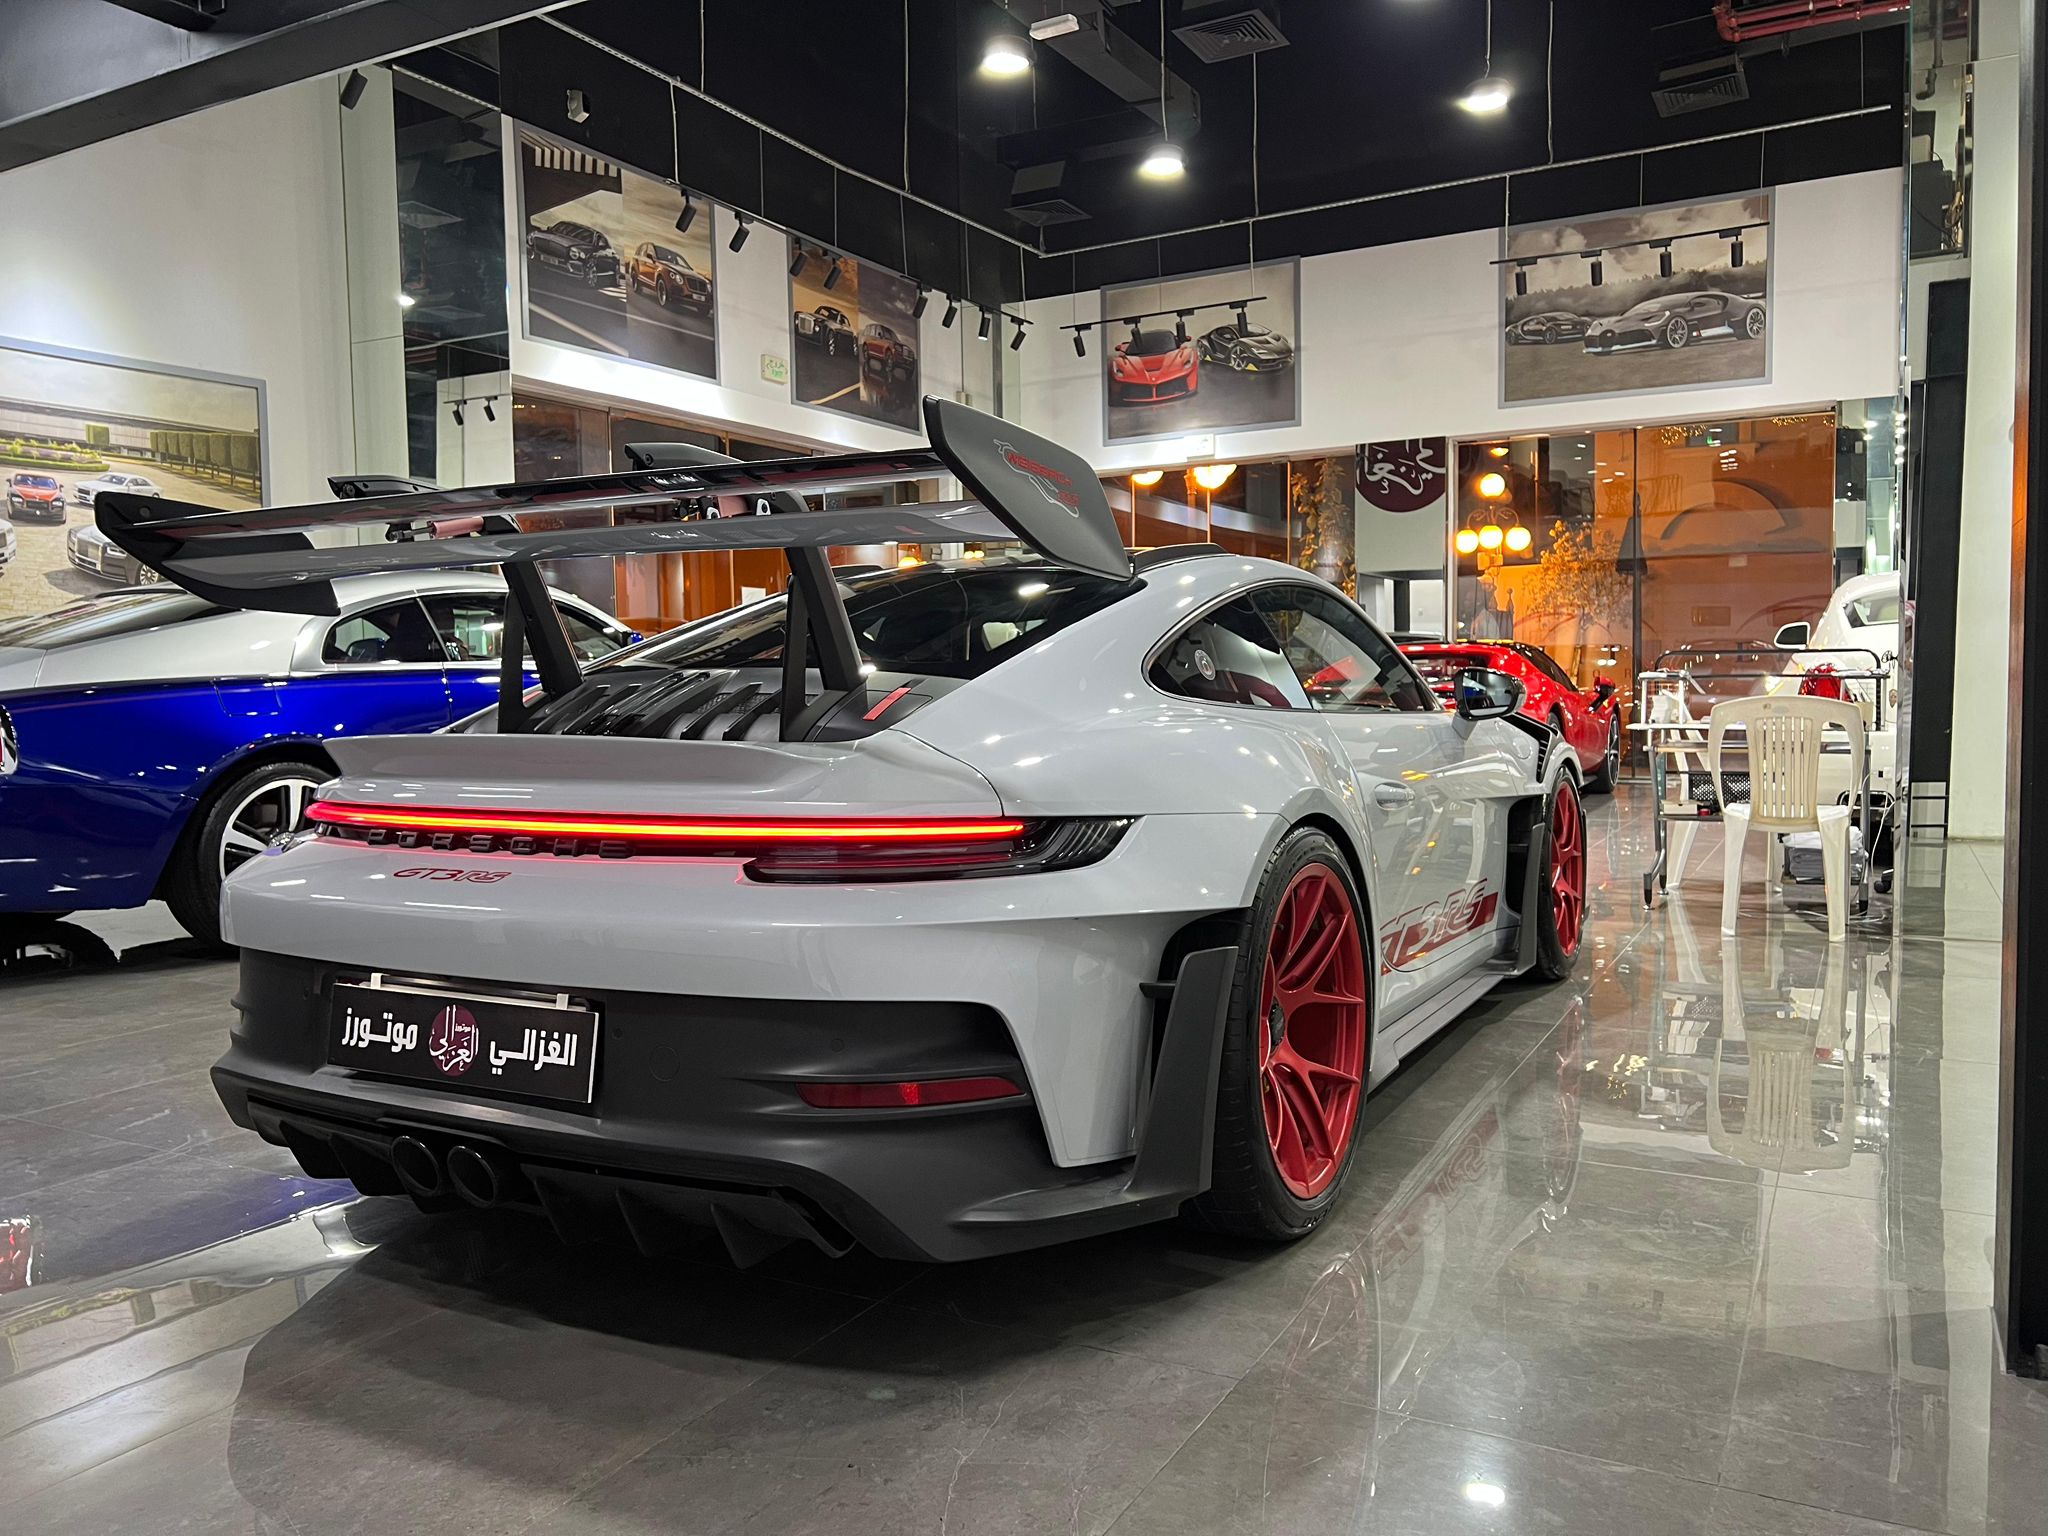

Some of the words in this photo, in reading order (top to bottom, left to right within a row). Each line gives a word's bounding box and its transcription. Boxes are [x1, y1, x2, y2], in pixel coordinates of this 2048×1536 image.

[367, 828, 633, 859] PORSCHE
[341, 1006, 419, 1053] موتورز
[489, 1027, 579, 1076] الغزالي
